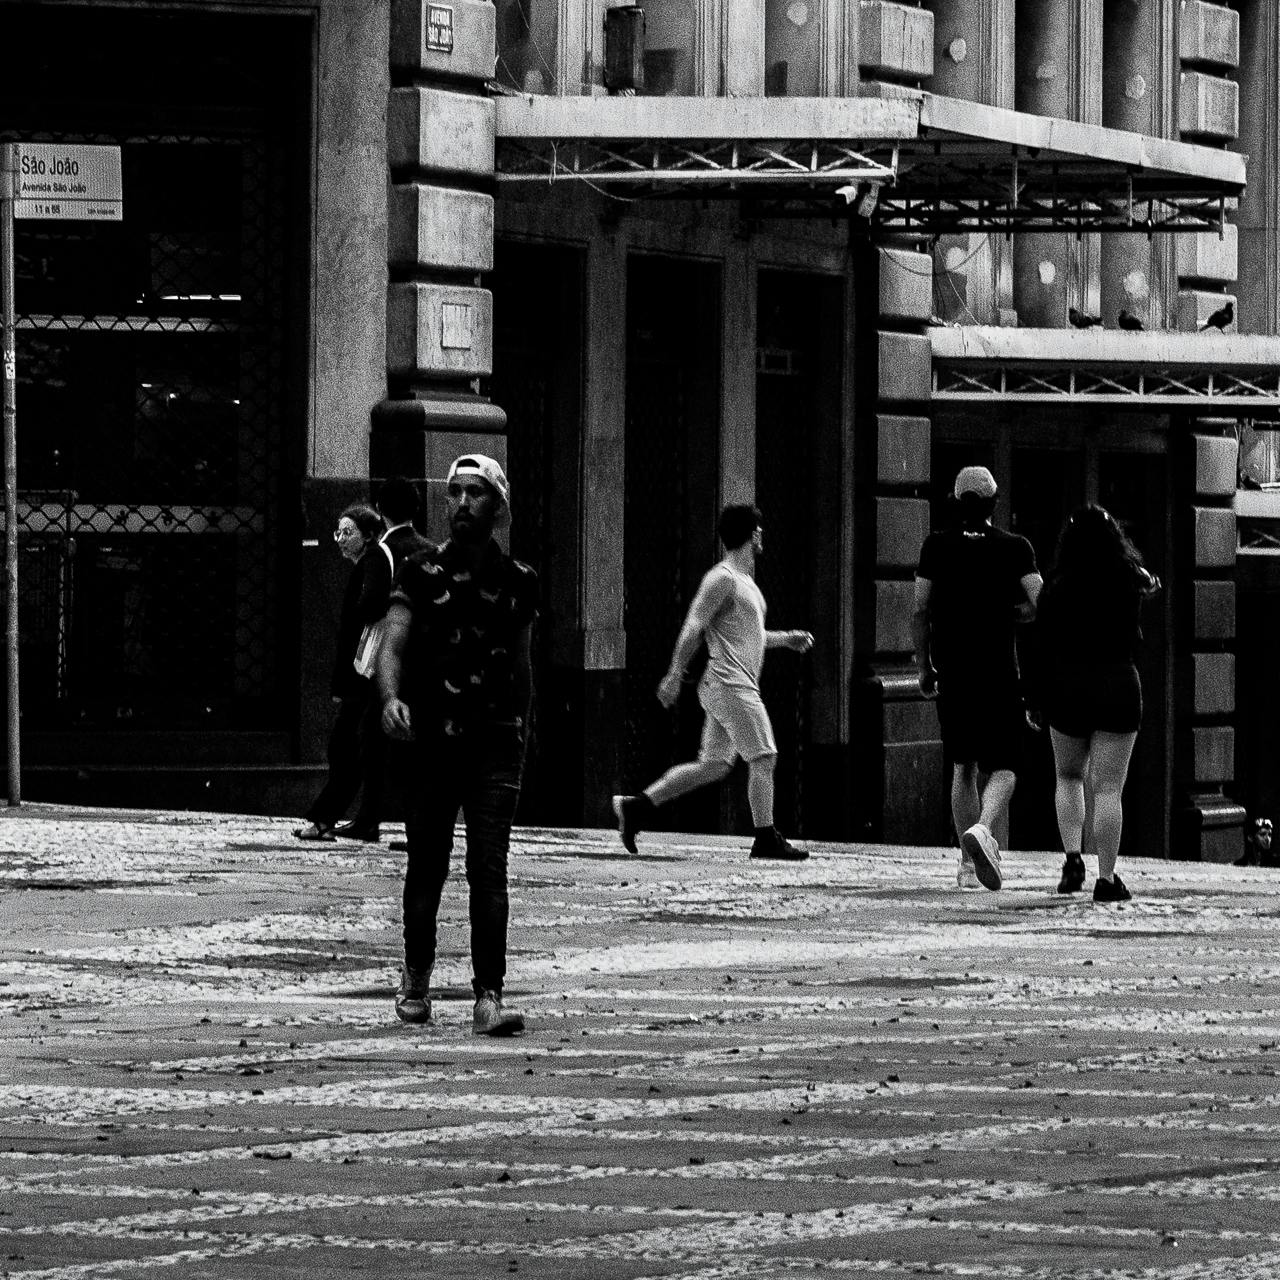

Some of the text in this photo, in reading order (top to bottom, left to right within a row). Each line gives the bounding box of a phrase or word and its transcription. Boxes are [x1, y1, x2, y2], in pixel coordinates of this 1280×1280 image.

[21, 154, 79, 176] São João
[22, 182, 87, 194] Avenida São João
[35, 204, 43, 214] 11
